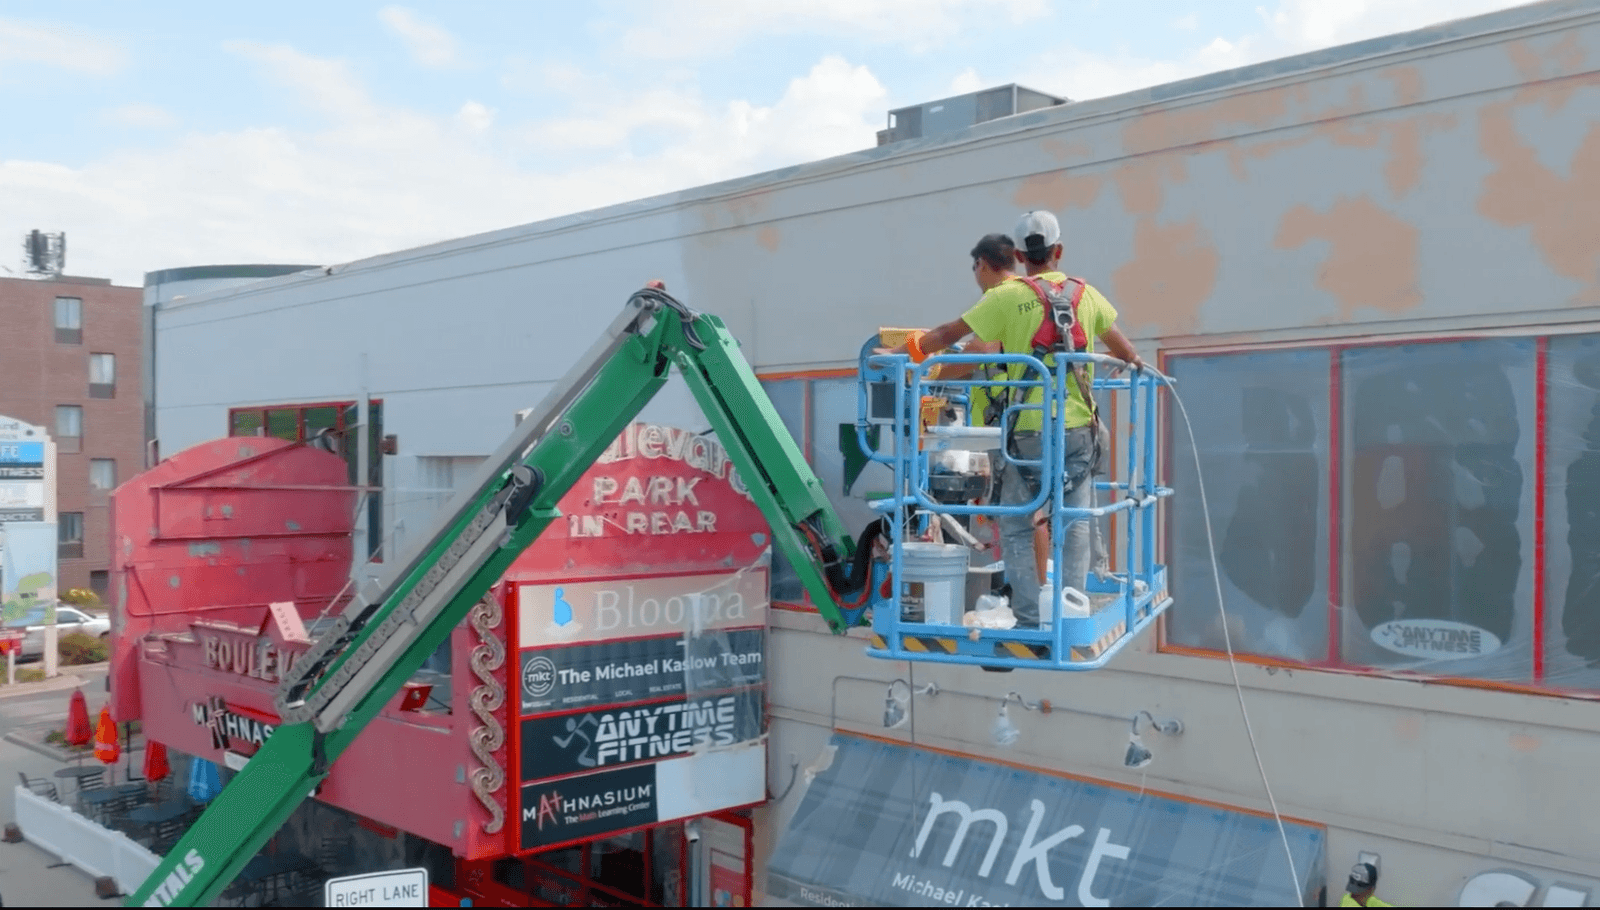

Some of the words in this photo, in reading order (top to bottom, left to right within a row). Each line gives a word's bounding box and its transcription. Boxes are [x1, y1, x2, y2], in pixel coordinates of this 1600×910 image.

[593, 475, 702, 506] PARK
[569, 514, 604, 537] IN
[626, 510, 718, 535] REAR
[1402, 626, 1481, 642] ANYTIME
[1403, 639, 1481, 654] FITNESS
[527, 671, 551, 683] mkt
[558, 668, 591, 685] The
[595, 660, 659, 681] Michael
[662, 655, 717, 674] Kaslow
[720, 652, 762, 667] Team
[594, 697, 735, 743] ANYTIME
[597, 723, 734, 766] FITNESS
[564, 815, 579, 825] The
[598, 805, 628, 818] Learning
[628, 801, 650, 813] Center
[909, 791, 1131, 908] mkt
[335, 887, 376, 908] RIGHT
[383, 883, 419, 901] LANE
[892, 872, 964, 906] Michael
